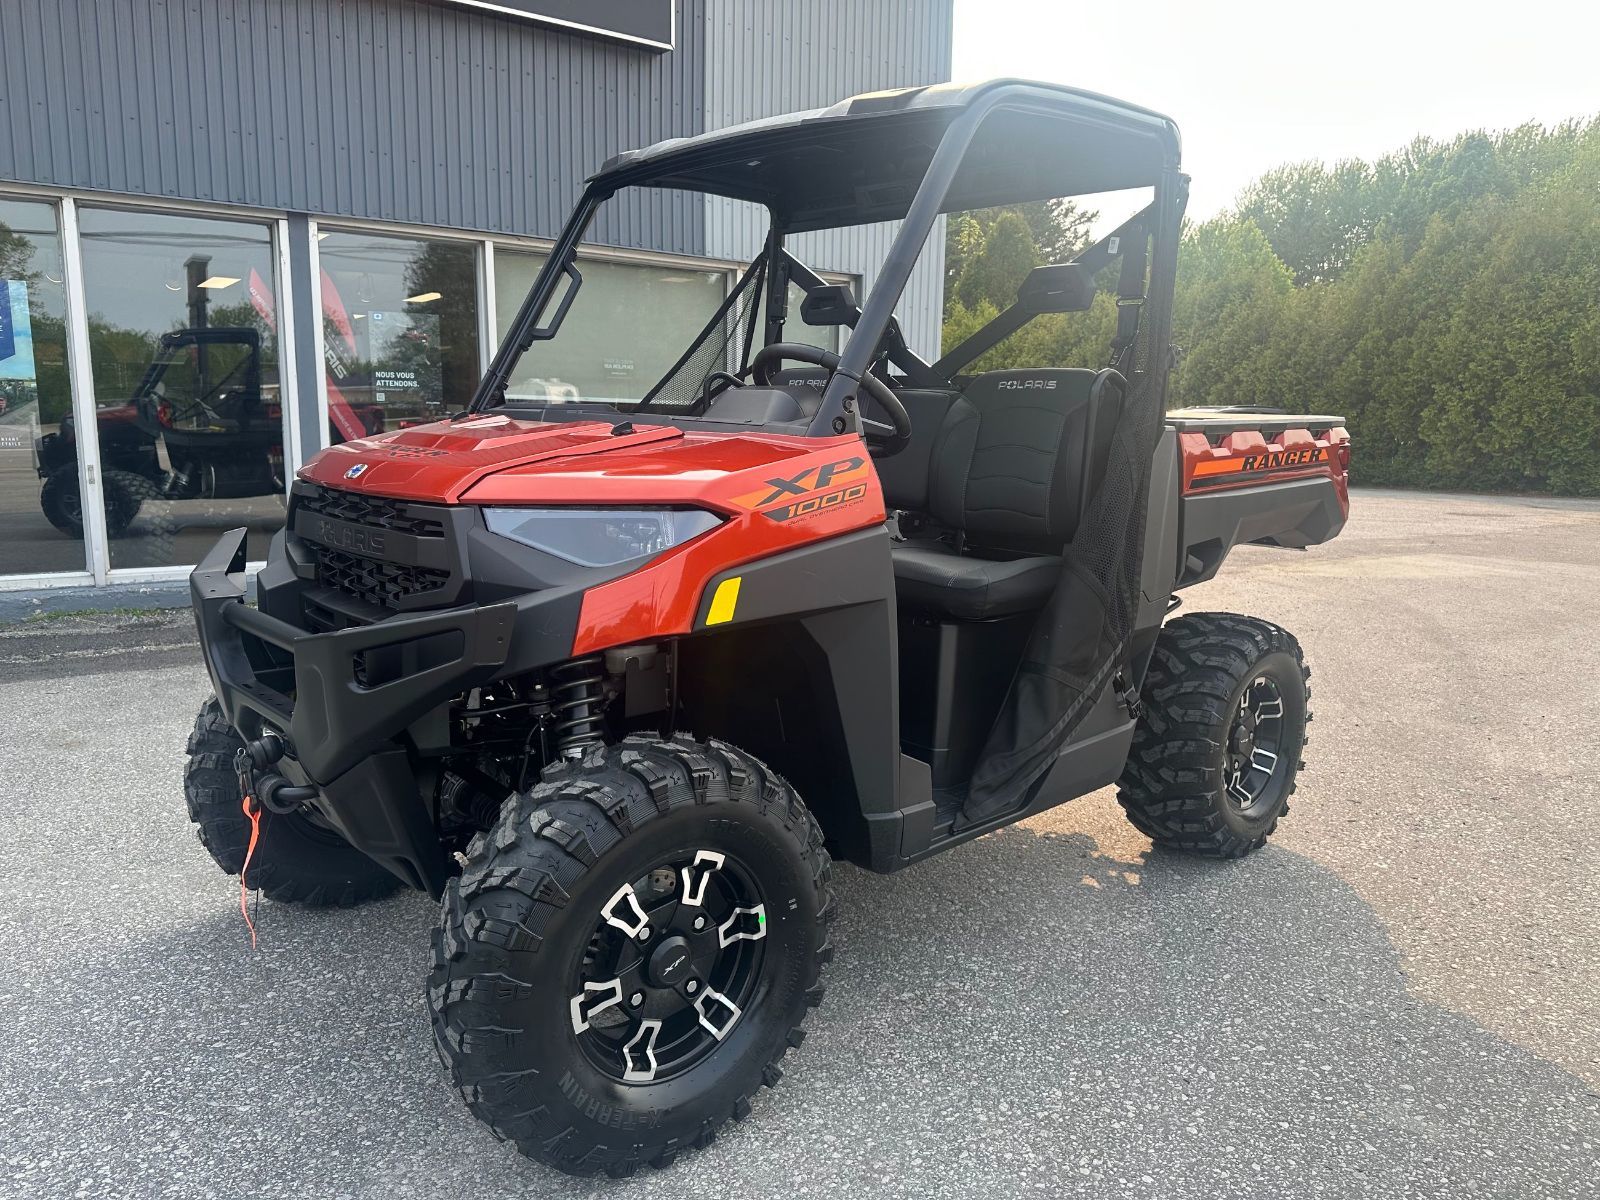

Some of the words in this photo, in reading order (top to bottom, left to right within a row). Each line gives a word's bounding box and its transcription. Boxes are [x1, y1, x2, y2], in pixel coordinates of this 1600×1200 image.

[998, 380, 1057, 389] POLARIS
[1242, 448, 1322, 471] RANGER
[754, 457, 865, 507] XP
[788, 484, 867, 518] 1000
[663, 955, 686, 976] XP
[557, 1069, 664, 1131] X-TERRAIN
